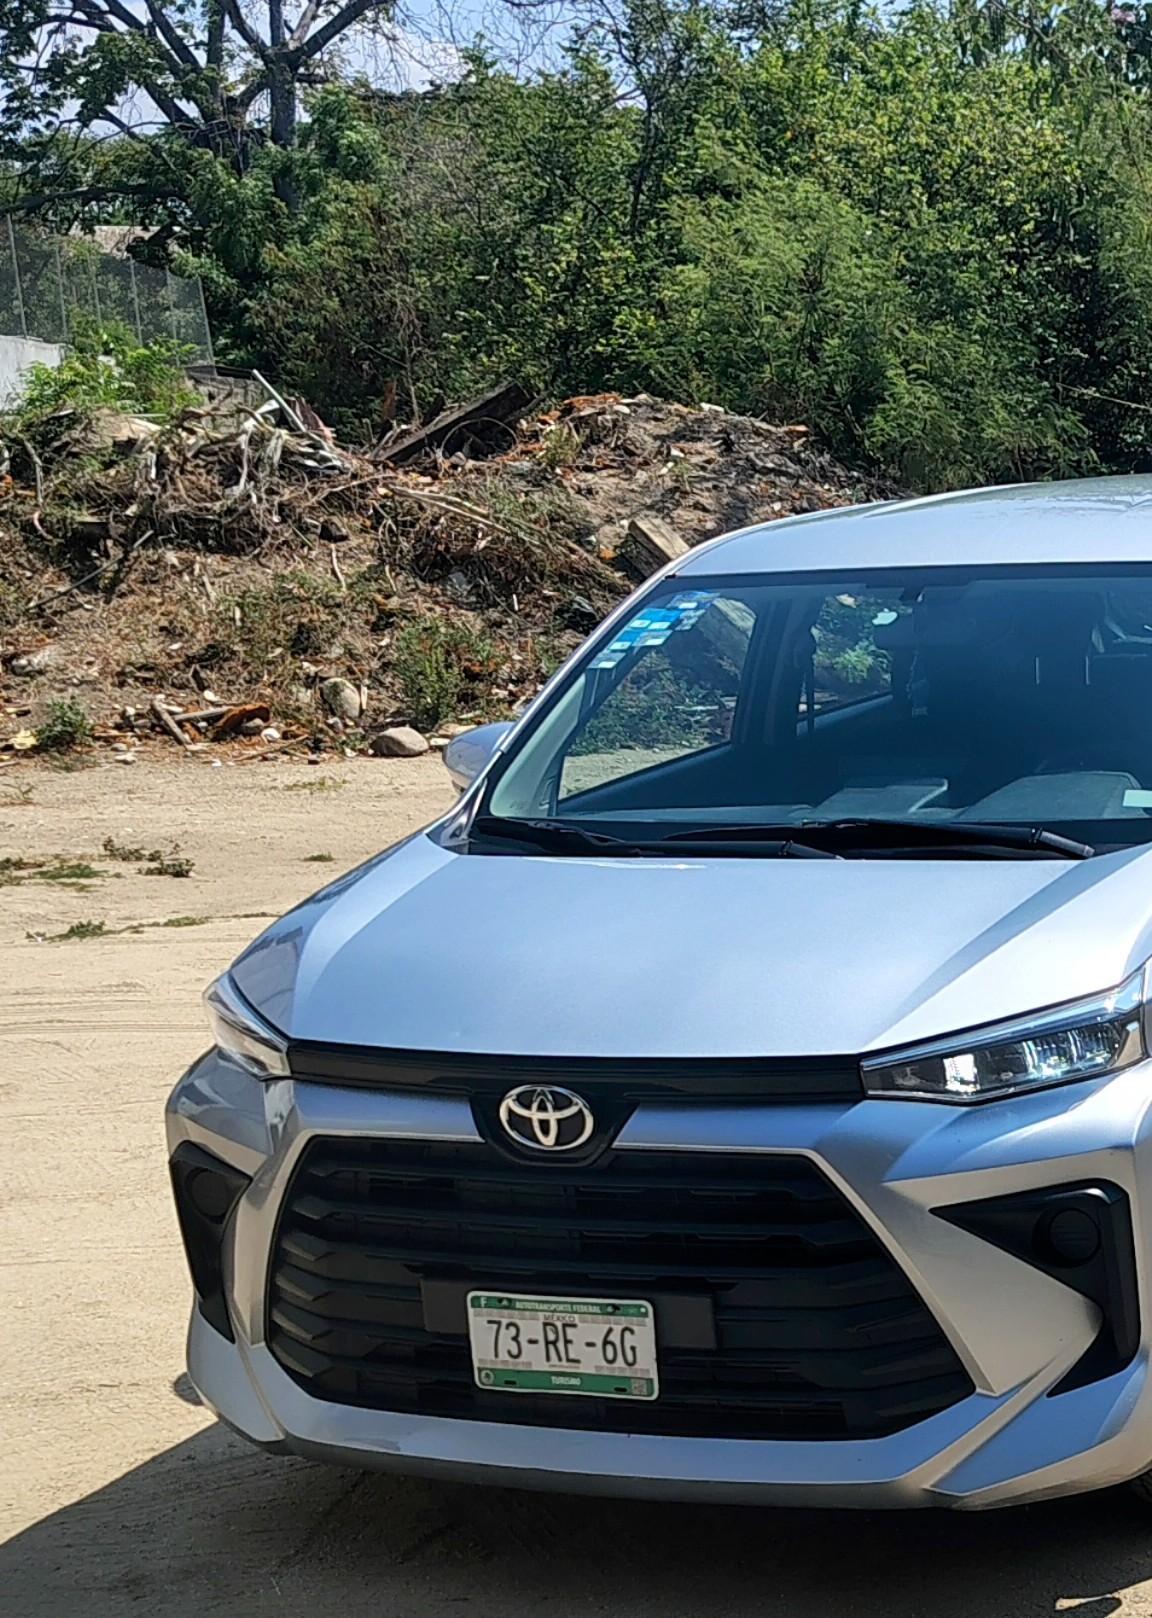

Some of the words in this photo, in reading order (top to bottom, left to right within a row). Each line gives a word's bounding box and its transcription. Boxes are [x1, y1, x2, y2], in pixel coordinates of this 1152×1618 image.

[515, 1301, 571, 1312] AUTOTRANSPORTE
[572, 1304, 602, 1314] FEDERAL
[486, 1320, 638, 1367] 73-RE-6G
[551, 1375, 581, 1386] TURISMO
